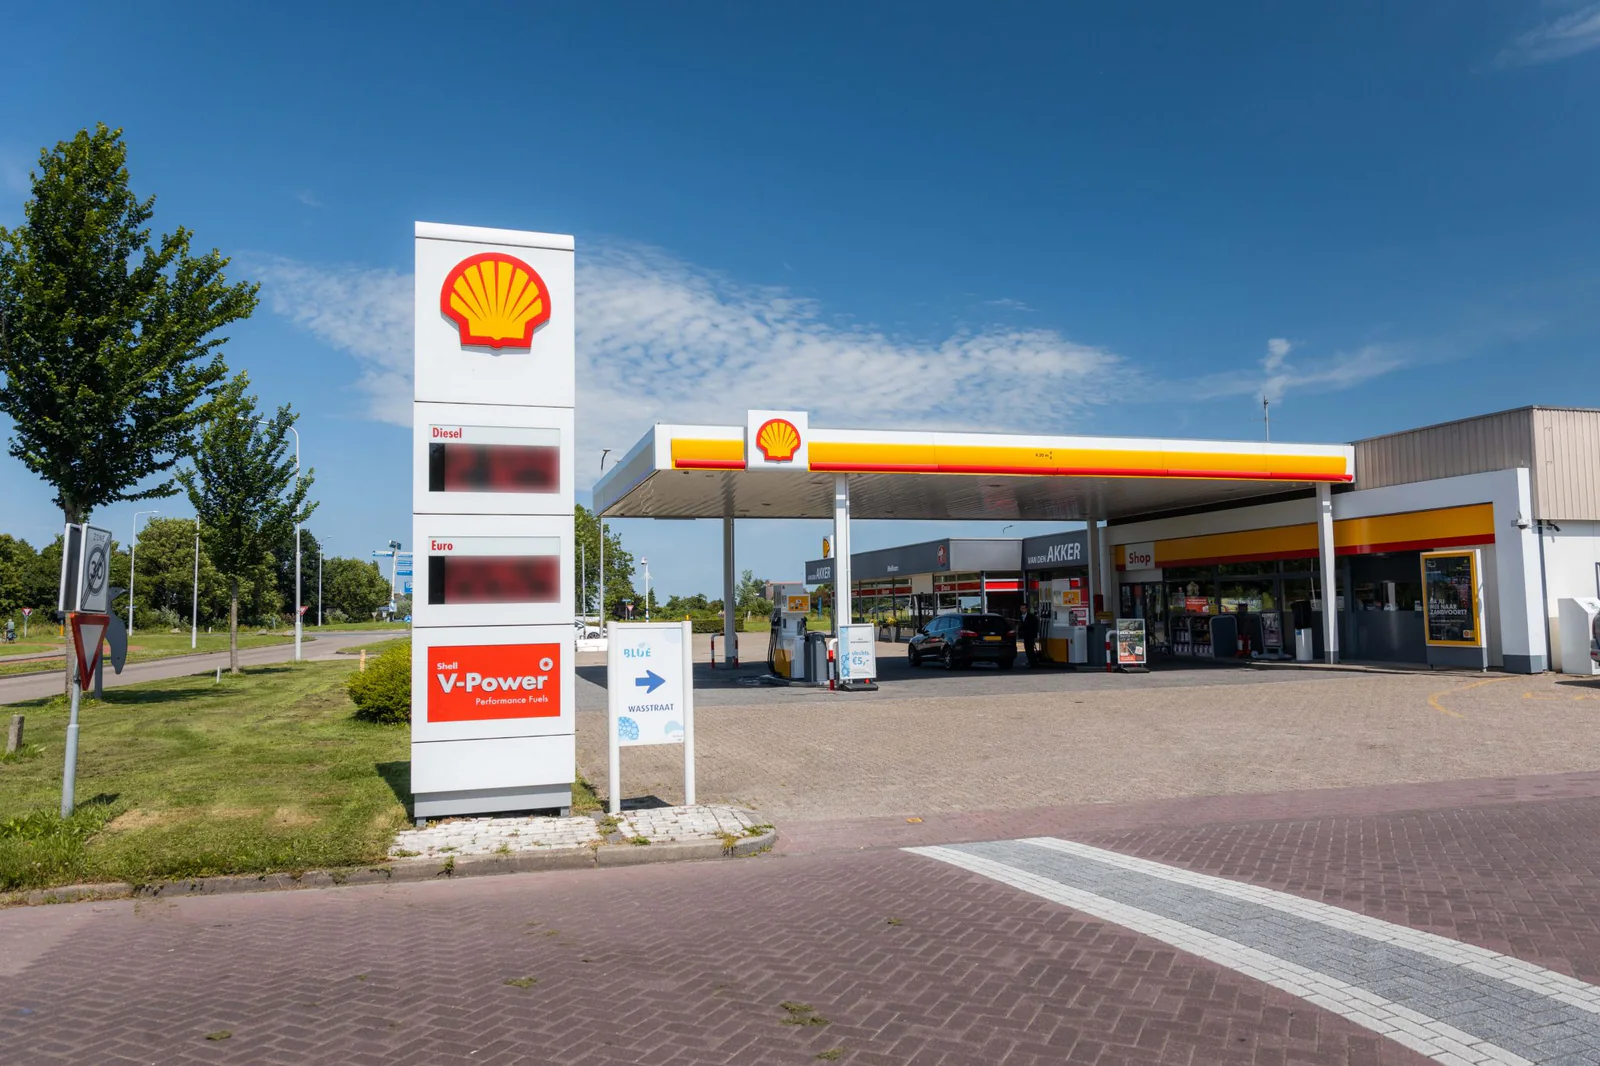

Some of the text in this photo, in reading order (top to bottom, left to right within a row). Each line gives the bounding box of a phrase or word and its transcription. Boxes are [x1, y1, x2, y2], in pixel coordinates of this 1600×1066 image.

[432, 427, 462, 438] Diesel
[431, 540, 453, 551] Euro
[1028, 543, 1081, 564] VAN DEN AKKER
[1129, 551, 1151, 566] Shop
[816, 567, 831, 579] AKKER
[437, 661, 458, 670] Shell
[437, 672, 548, 693] V-Power
[475, 695, 549, 705] Performance Fuels
[628, 703, 674, 712] WASSTRAAT
